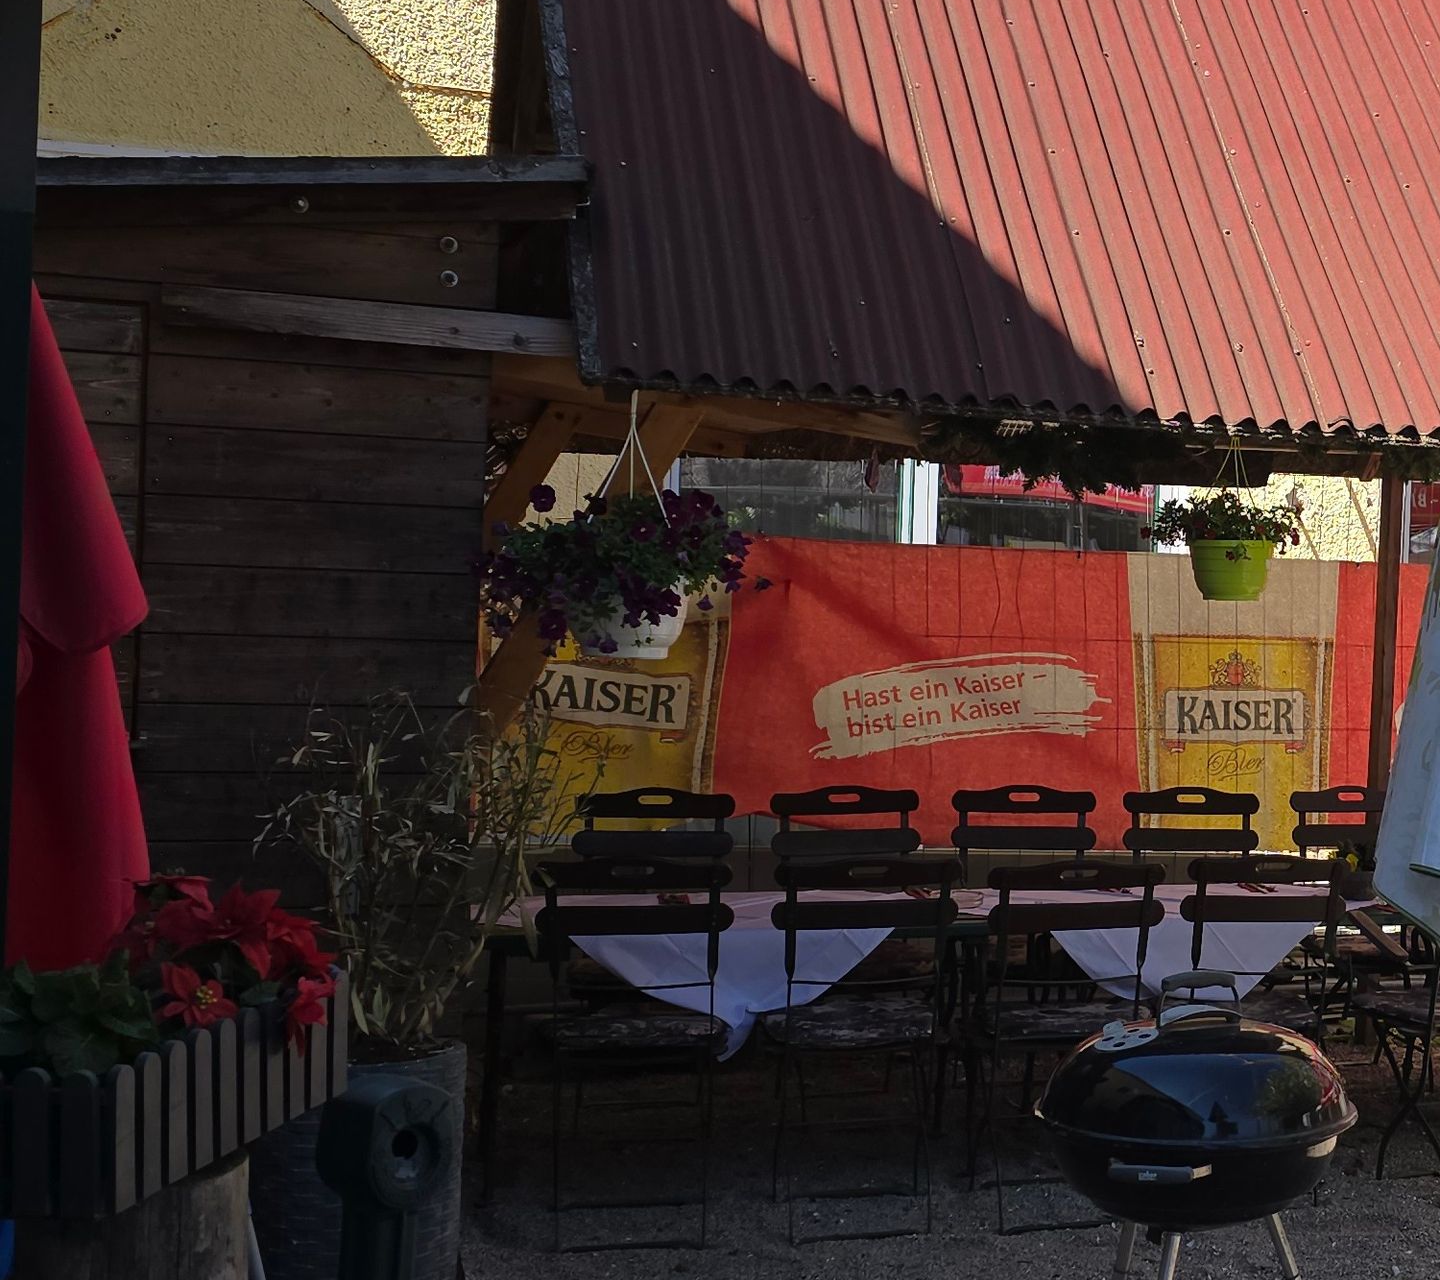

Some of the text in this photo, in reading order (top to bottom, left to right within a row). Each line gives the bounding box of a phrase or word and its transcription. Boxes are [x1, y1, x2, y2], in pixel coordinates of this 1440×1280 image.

[528, 669, 676, 724] KAISER
[843, 684, 904, 712] Hast
[909, 679, 949, 702] ein
[953, 671, 1025, 696] Kaiser
[847, 697, 1021, 739] bist ein Kaiser
[1177, 696, 1295, 735] KAISER
[1207, 747, 1265, 781] Bier
